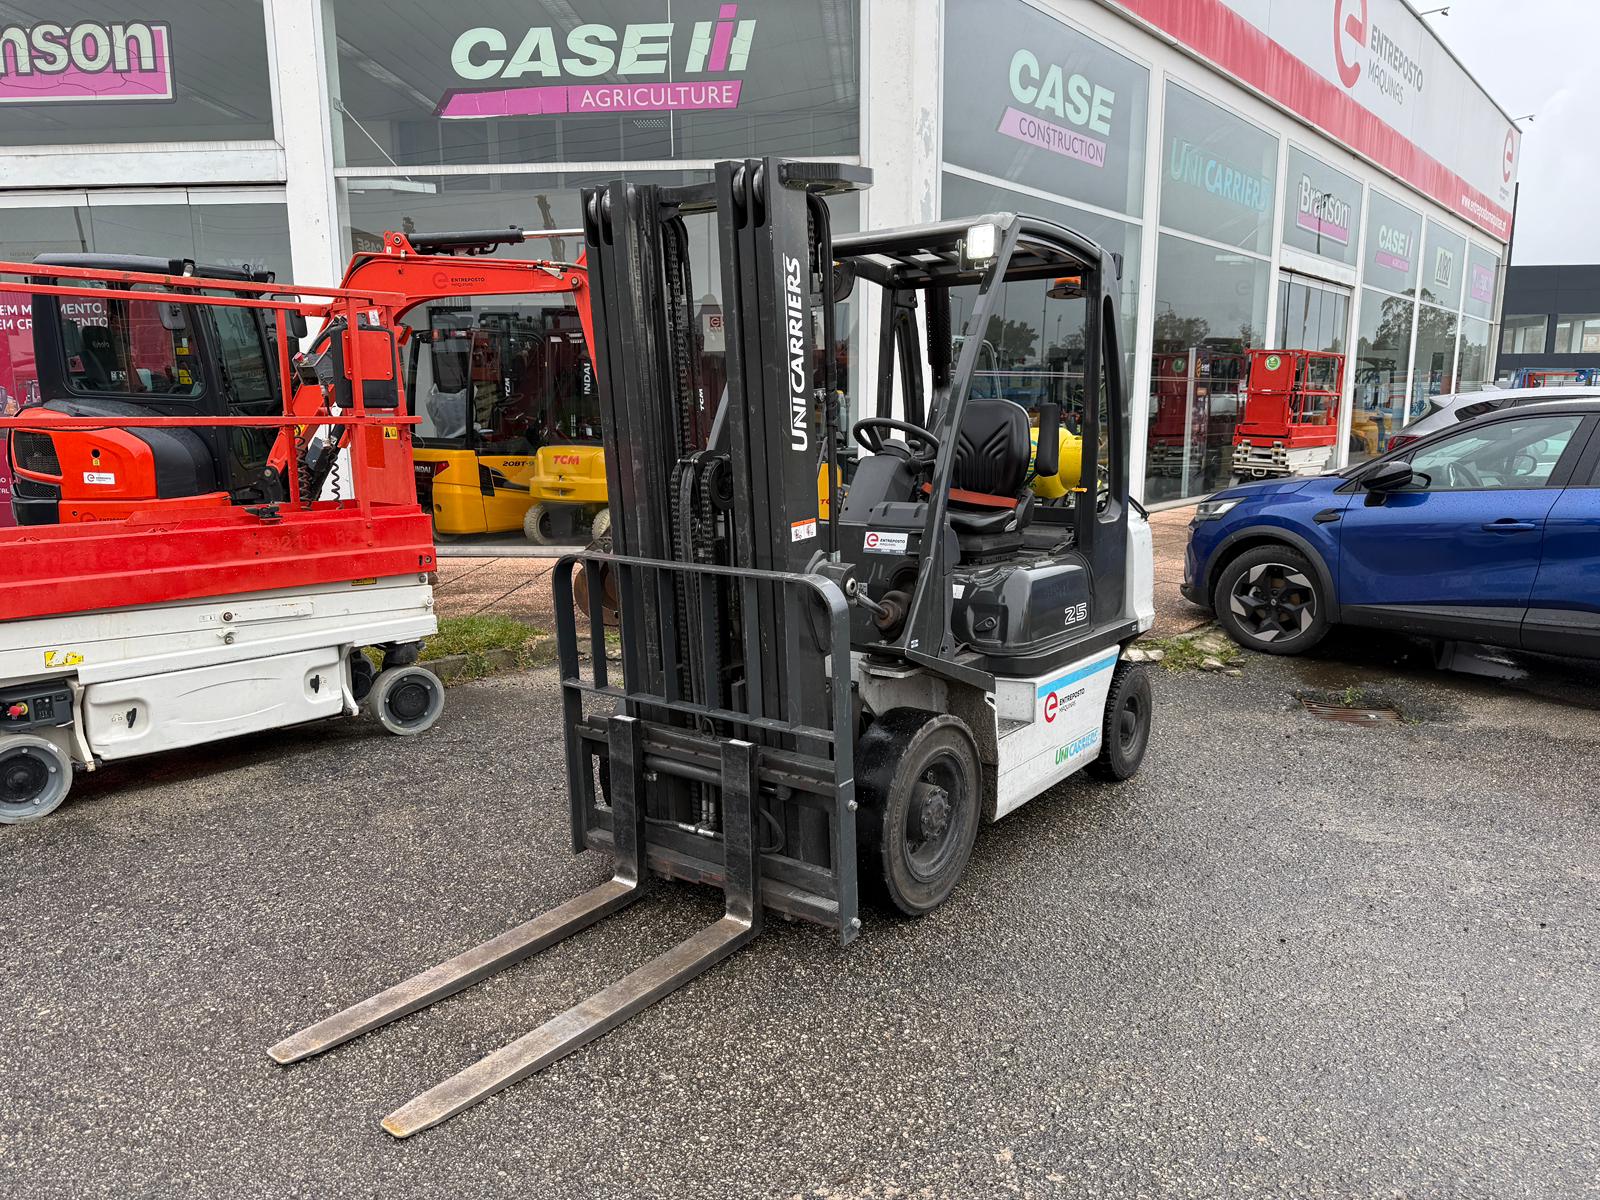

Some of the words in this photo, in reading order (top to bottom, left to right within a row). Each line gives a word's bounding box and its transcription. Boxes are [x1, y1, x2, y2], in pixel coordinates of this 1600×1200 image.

[451, 24, 675, 80] CASE
[1370, 24, 1424, 92] ENTREPOSTO
[580, 86, 733, 108] AGRICULTURE
[1009, 49, 1116, 136] CASE
[1018, 117, 1105, 163] CONSTRUCTION
[1300, 174, 1349, 229] Branson
[1379, 225, 1405, 256] CASE
[553, 455, 580, 465] TCM
[1064, 602, 1087, 626] 25
[1060, 687, 1086, 706] ENTREPOSTO
